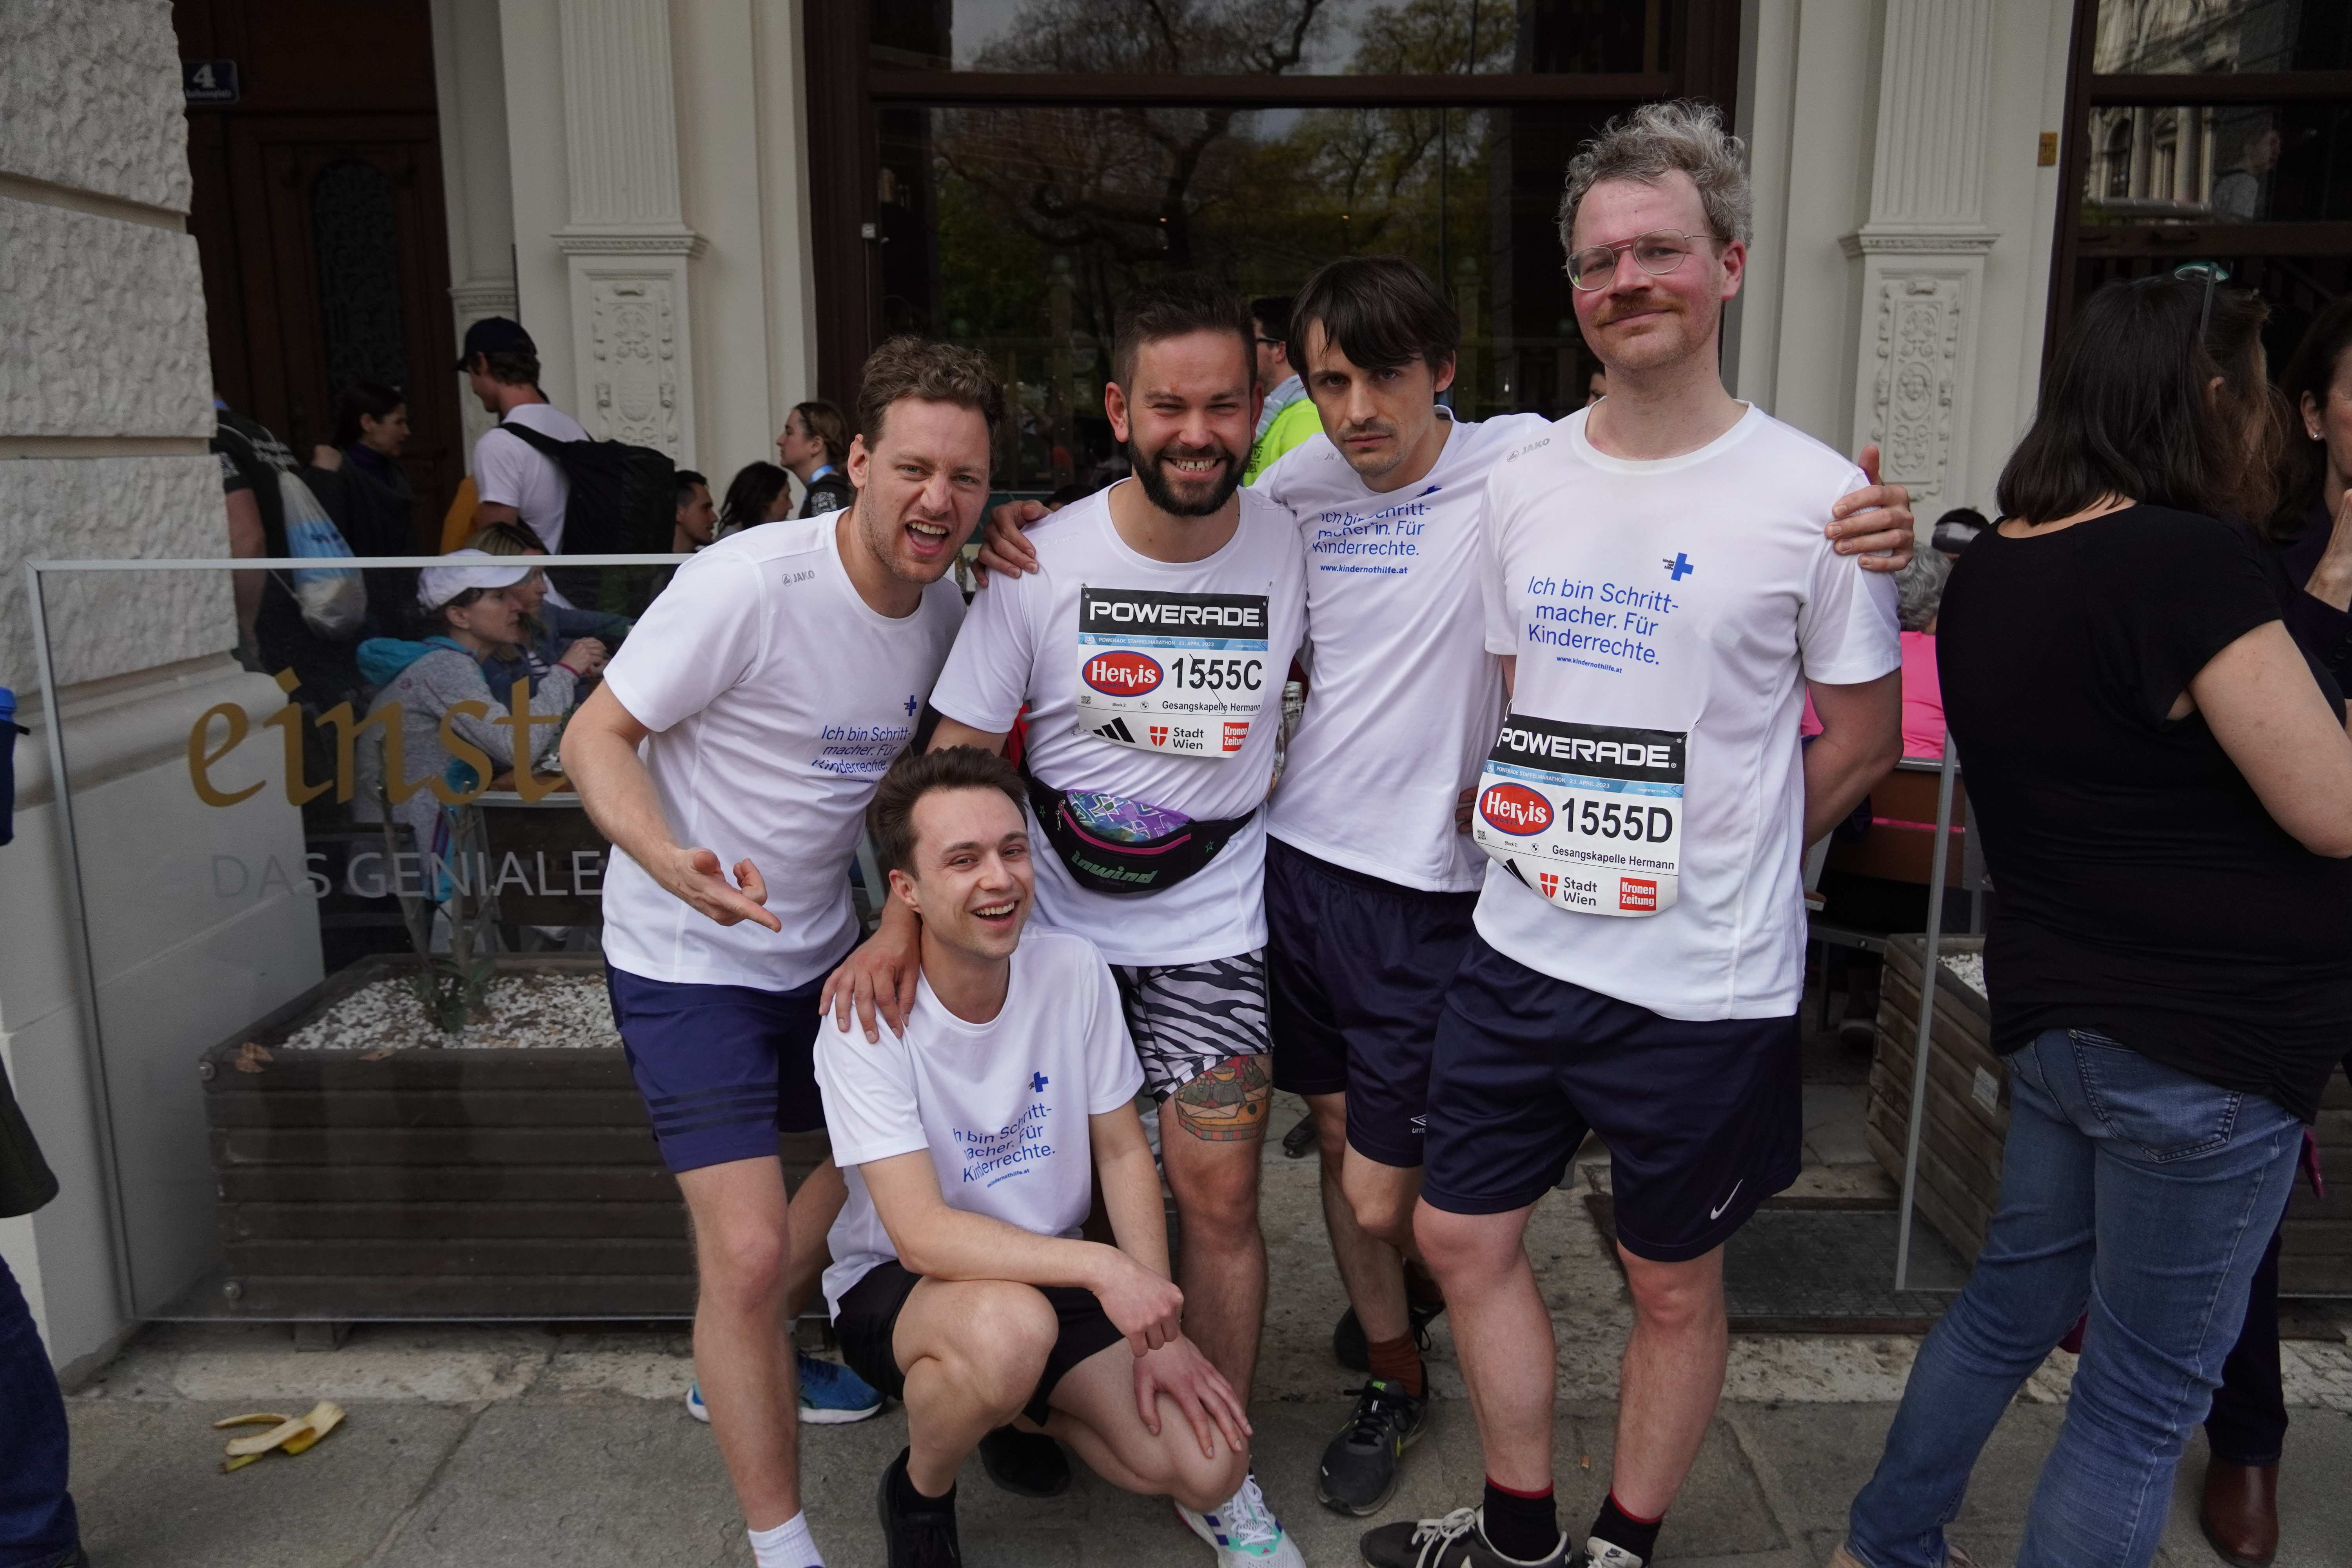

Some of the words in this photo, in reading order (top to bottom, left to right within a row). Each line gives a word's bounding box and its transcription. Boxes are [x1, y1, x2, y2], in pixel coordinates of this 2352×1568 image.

[193, 64, 216, 89] 4
[1522, 438, 1550, 455] JAKO
[1396, 521, 1425, 535] Für
[1312, 539, 1419, 555] Kinderrechte.
[793, 570, 815, 583] JAKO
[1320, 564, 1408, 574] www.kindernothilfe.at
[1528, 576, 1555, 595] Ich
[1561, 579, 1593, 599] bin
[1600, 583, 1678, 613] Schritt-
[1536, 605, 1617, 629] macher.
[1624, 612, 1659, 636] Für
[1529, 624, 1659, 665] Kinderrechte.
[1557, 657, 1622, 673] www.kindernothilfe.at
[1092, 661, 1156, 687] Hervis
[1172, 657, 1262, 690] 1555C
[1162, 701, 1228, 712] Gesangskapelle
[1230, 703, 1260, 711] Hermann
[822, 725, 844, 740] Ich
[847, 727, 867, 741] bin
[871, 727, 911, 741] Schritt-
[1174, 727, 1204, 738] Stadt
[1225, 726, 1247, 735] Kronen
[823, 745, 875, 755] macher.
[877, 744, 897, 755] Für
[1173, 739, 1203, 750] Wien
[1497, 766, 1519, 775] POWERADE
[1519, 771, 1566, 783] STAFFELMARATHON
[1486, 791, 1546, 825] Hervis
[1491, 816, 1517, 826] SPORTS
[1562, 798, 1673, 843] 1555D
[1552, 845, 1625, 864] Gesangskapelle
[1629, 856, 1674, 869] Hermann
[212, 851, 331, 898] DAS
[348, 850, 601, 898] GENIALE
[1071, 850, 1158, 884] inwind
[1564, 877, 1597, 893] Stadt
[1622, 882, 1654, 895] Kronen
[1564, 890, 1596, 906] Wien
[1621, 894, 1654, 906] Zeitung
[967, 1131, 994, 1143] bin
[1000, 1103, 1051, 1139] Schritt-
[1020, 1125, 1043, 1143] Für
